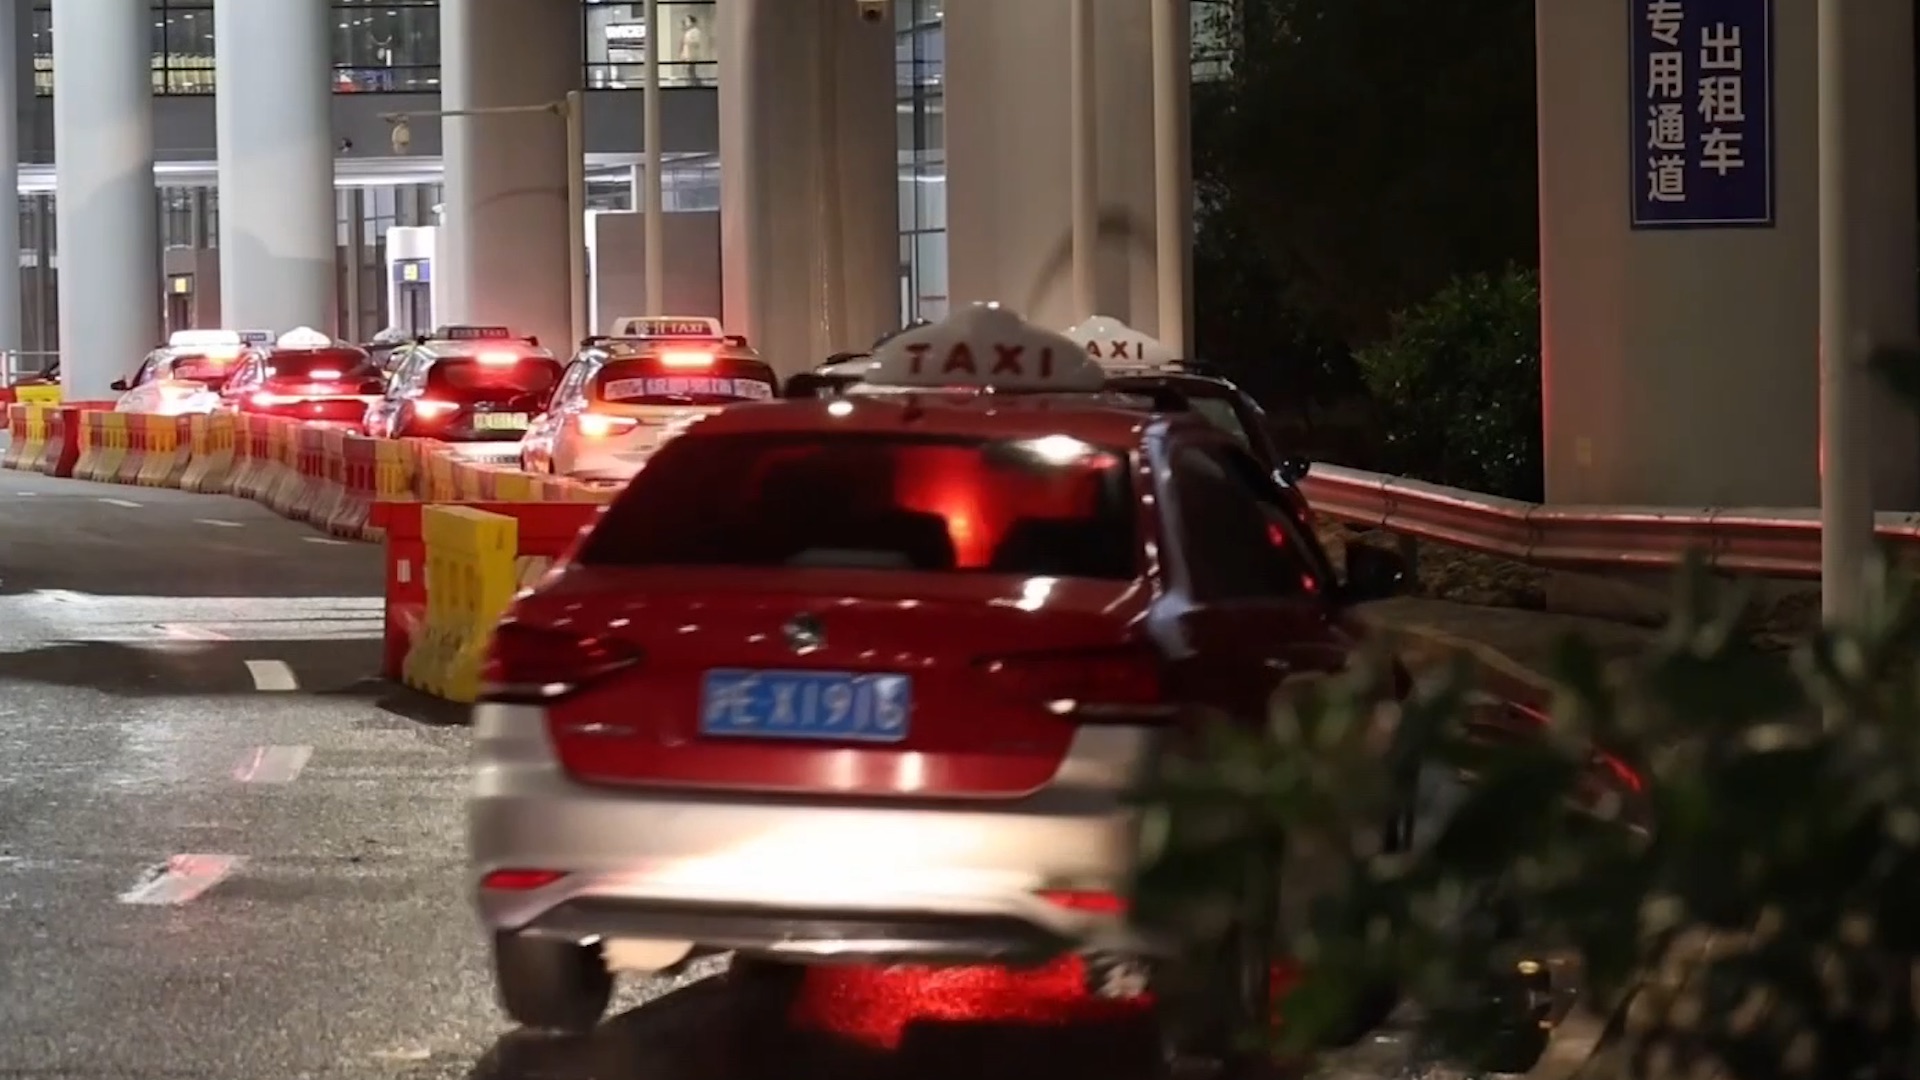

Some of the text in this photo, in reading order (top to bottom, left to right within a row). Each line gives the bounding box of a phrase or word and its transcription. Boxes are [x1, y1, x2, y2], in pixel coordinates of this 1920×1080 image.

[1646, 0, 1686, 202] 专用通道
[1698, 22, 1745, 176] 出租车
[905, 341, 1054, 378] TAXI
[1086, 340, 1143, 360] AXI
